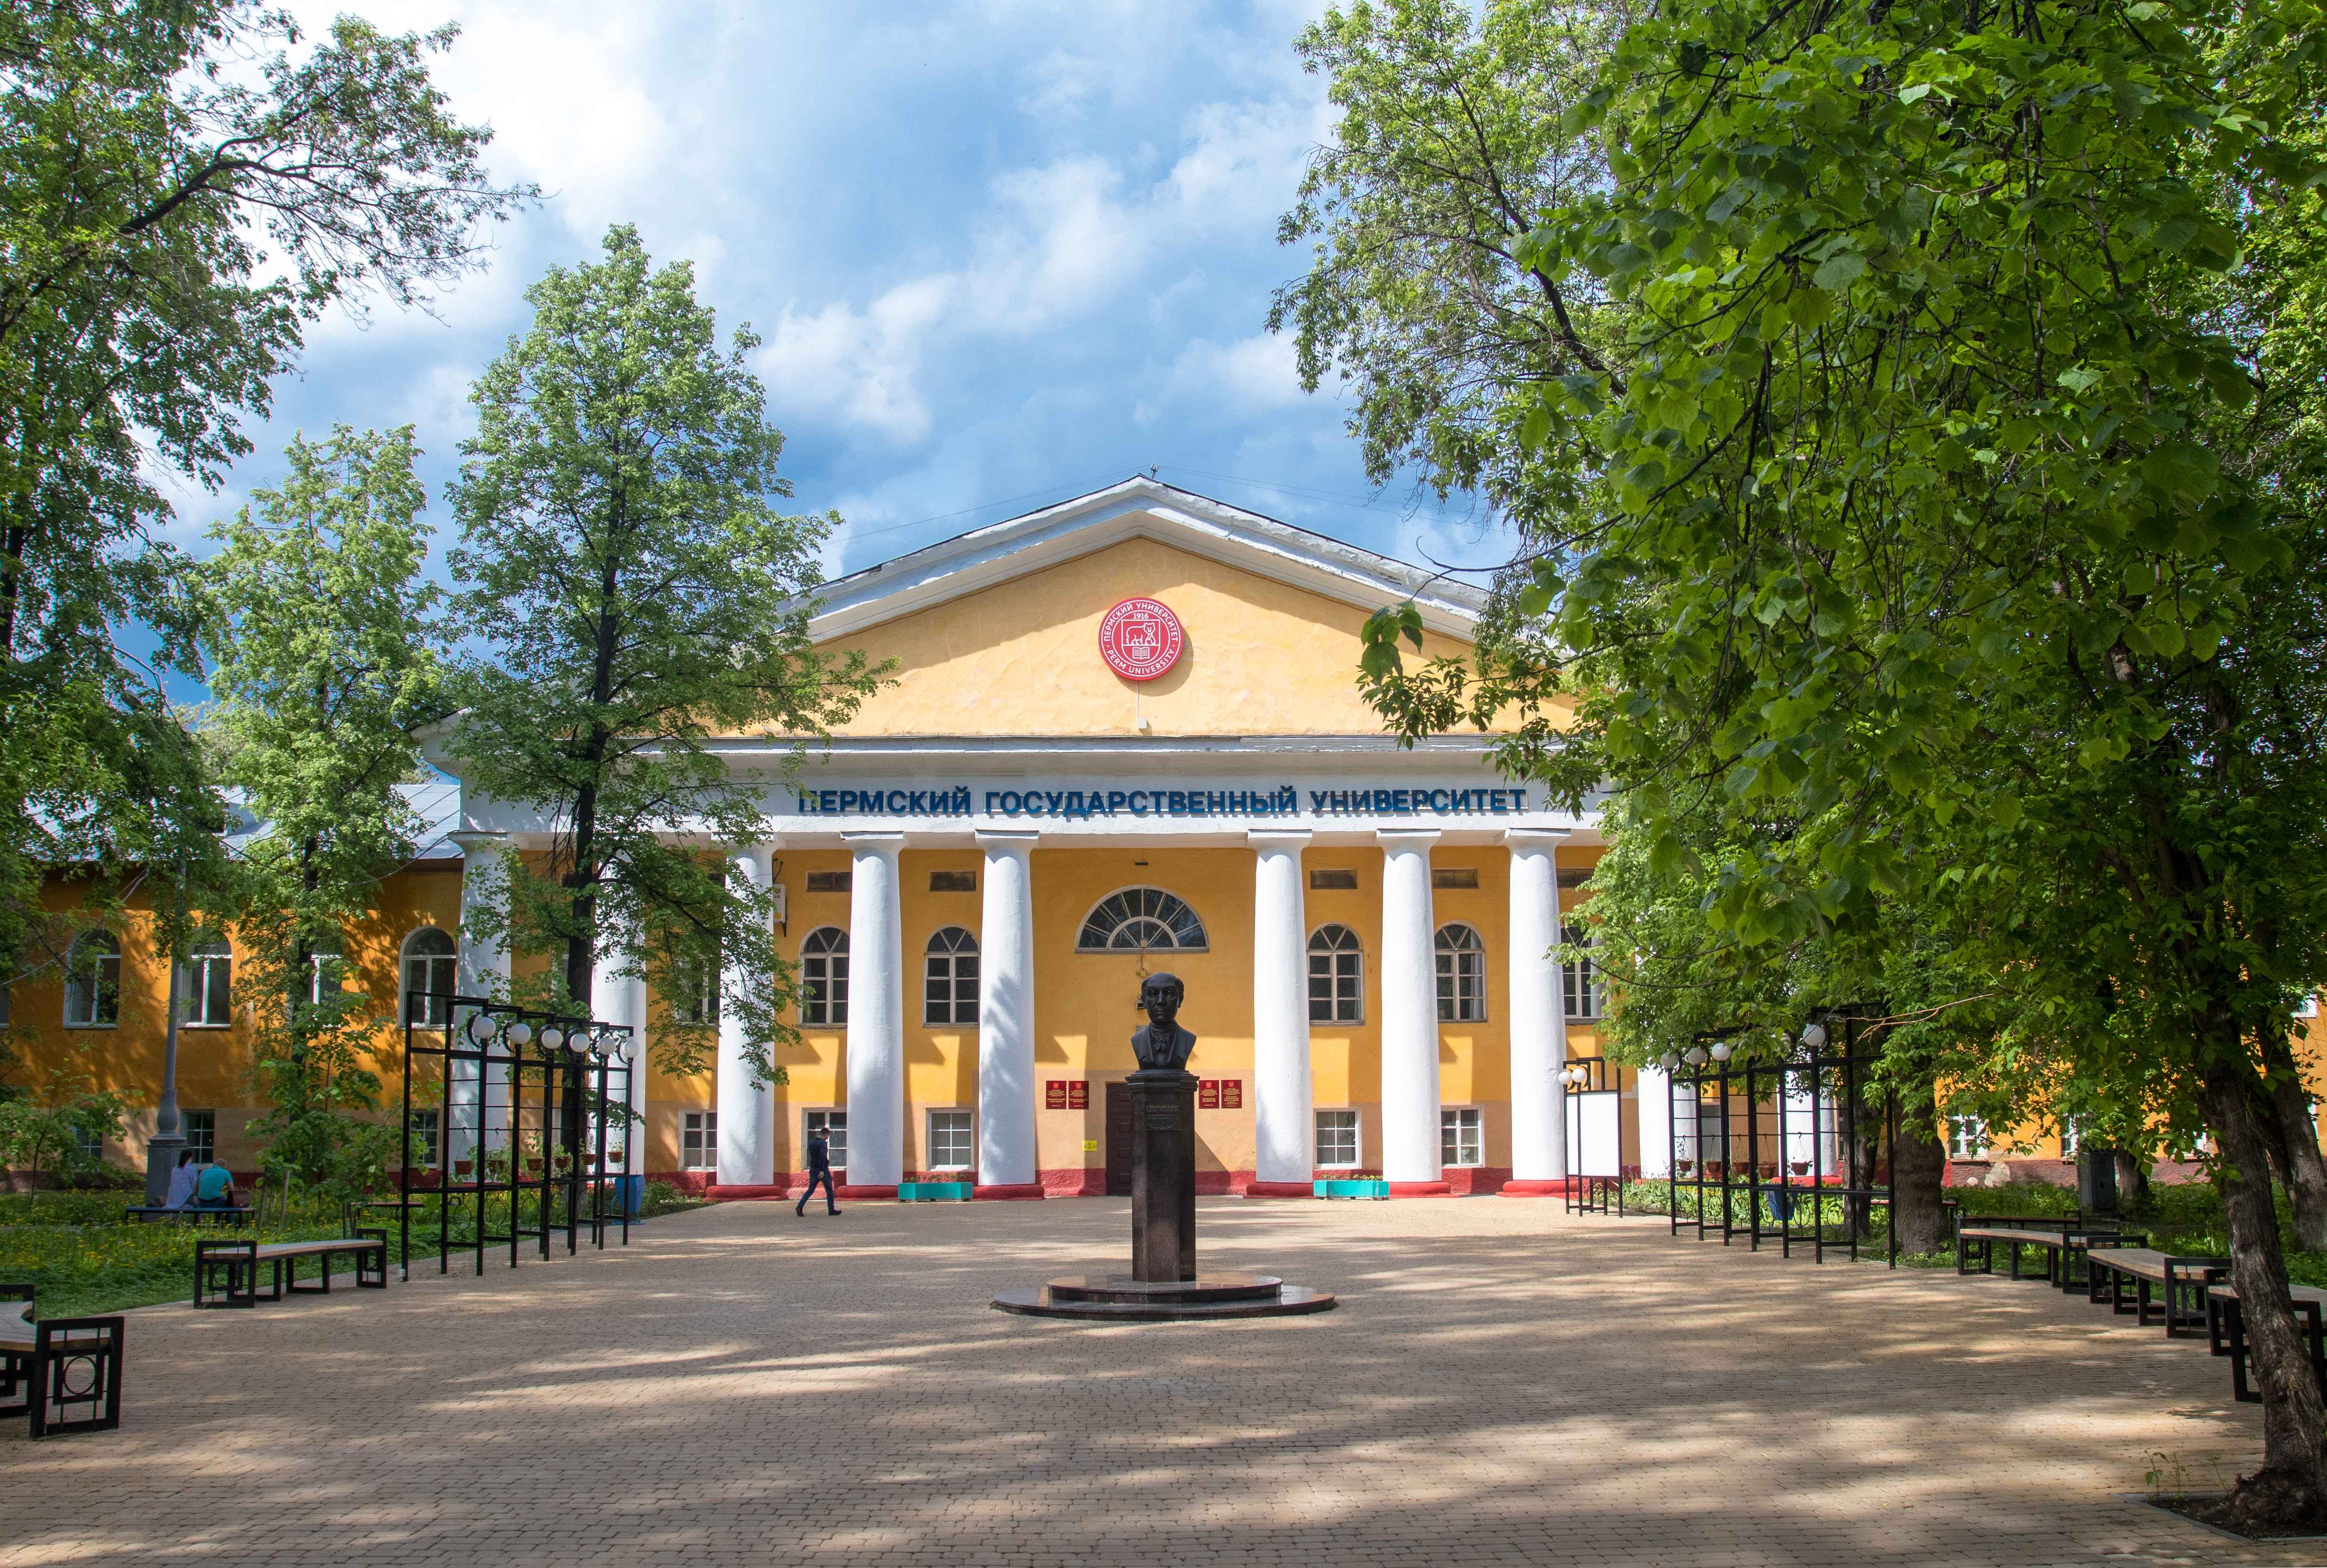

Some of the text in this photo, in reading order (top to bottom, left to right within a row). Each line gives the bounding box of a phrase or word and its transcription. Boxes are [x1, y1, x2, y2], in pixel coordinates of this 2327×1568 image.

[1104, 602, 1178, 642] ПЕРМСКИЙ УНИВЕРСИТЕТ
[1107, 648, 1175, 674] PERM UNIVERSITY
[985, 785, 1297, 817] ГОСУДАРСТВЕННЫЙ
[1309, 789, 1526, 812] УНИВЕРСИТЕТ
